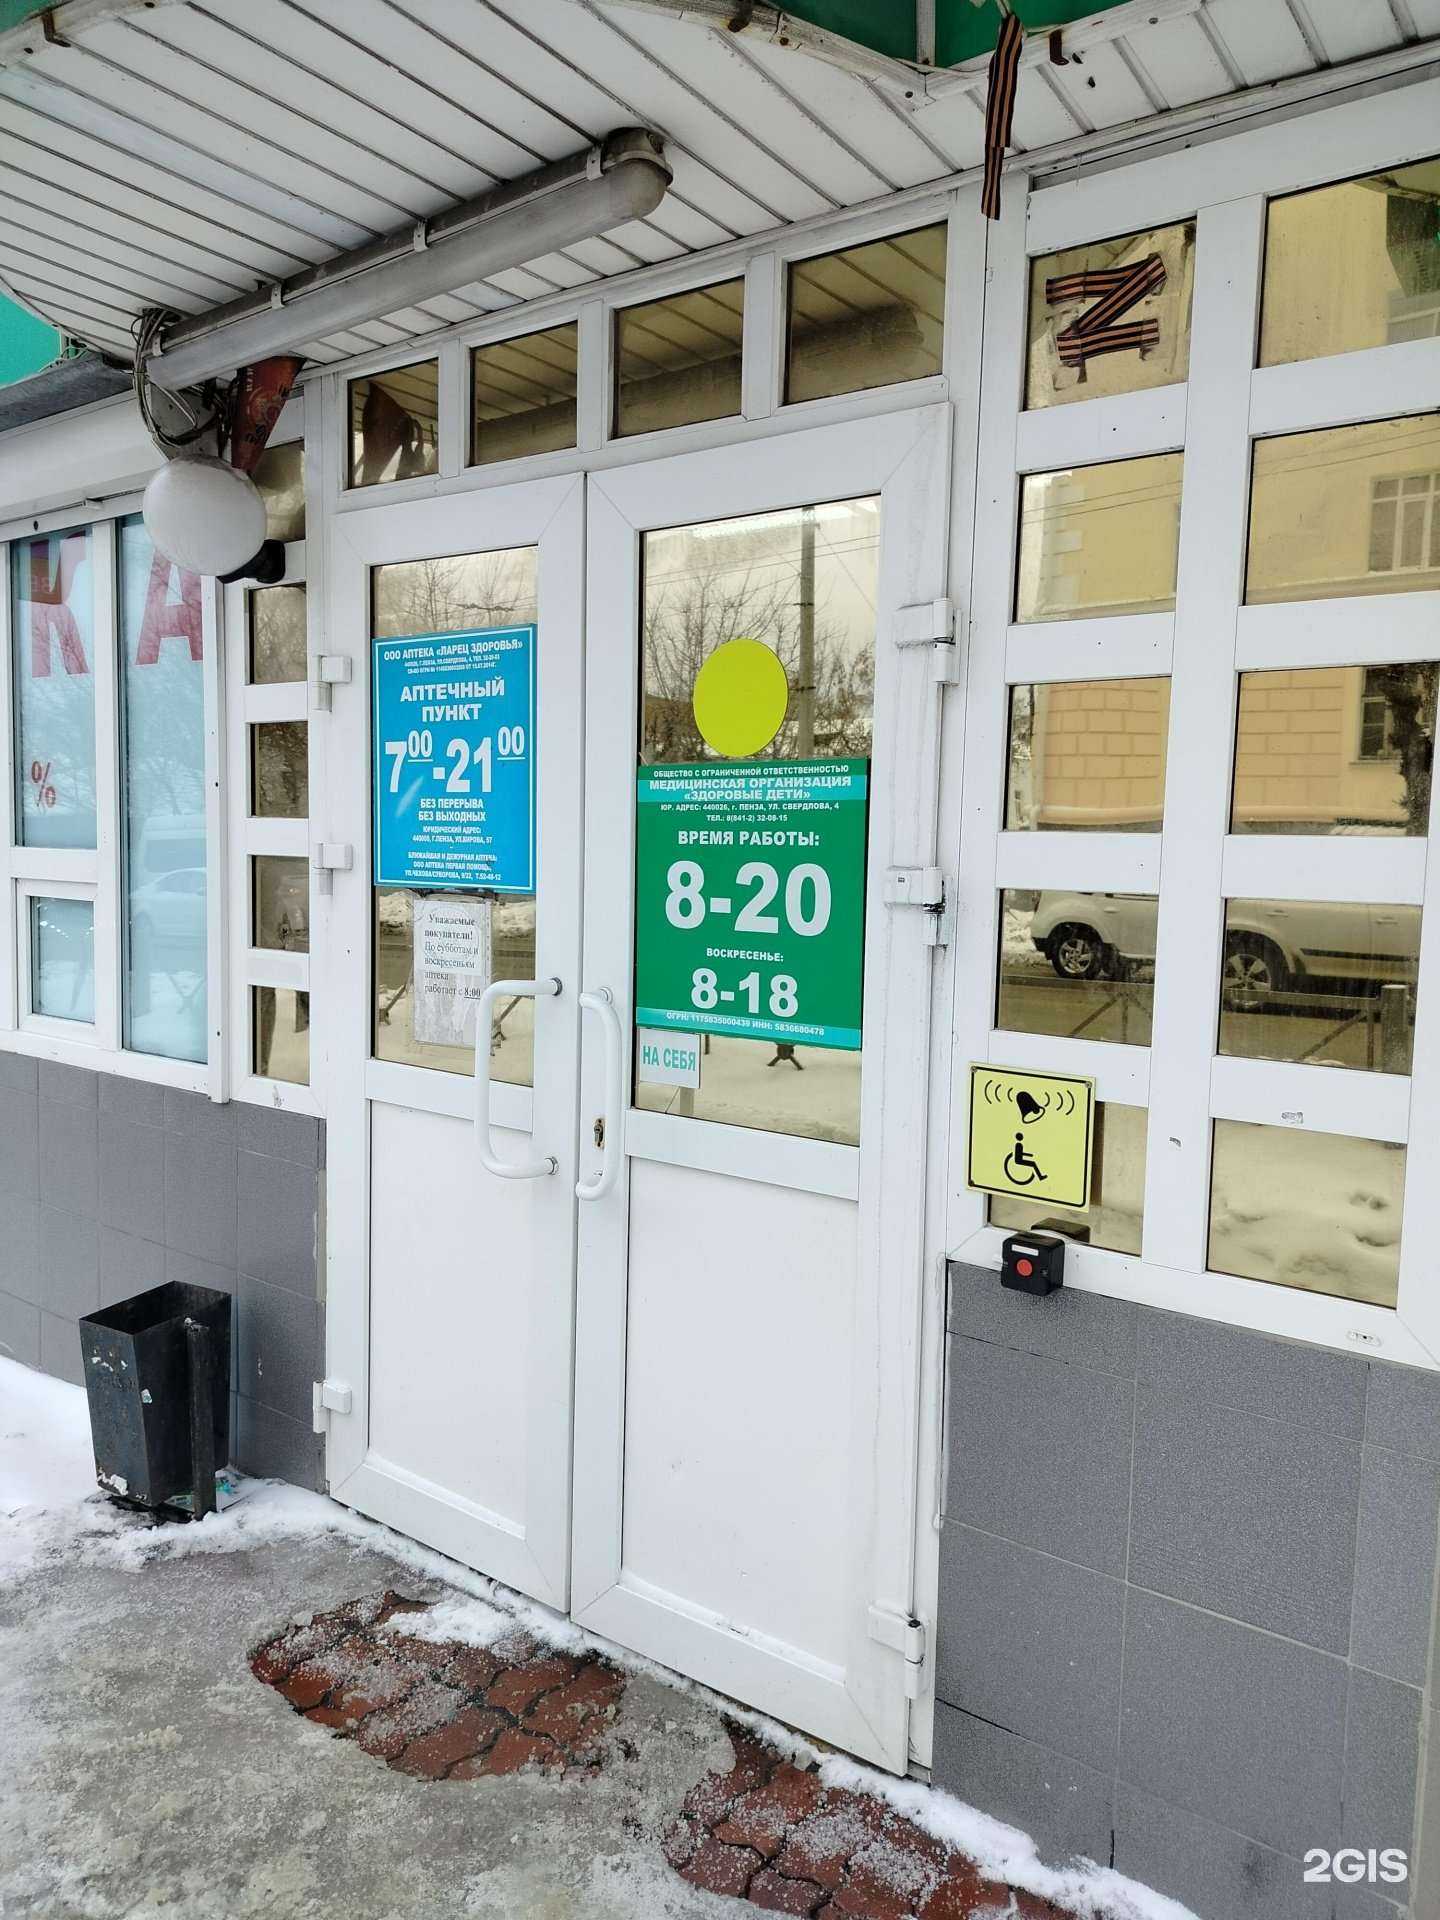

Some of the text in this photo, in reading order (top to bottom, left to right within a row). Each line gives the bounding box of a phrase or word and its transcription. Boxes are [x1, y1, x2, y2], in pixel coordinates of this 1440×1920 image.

[384, 639, 522, 661] ООО АПТЕКА «ЛАРЕЦ ЗДОРОВЬЯ»
[400, 676, 505, 702] АПТЕЧНЫЙ
[422, 704, 482, 722] ПУНКТ
[654, 770, 693, 778] ОБЩЕСТВО
[702, 767, 761, 777] ОГРАНИЧЕННОЙ
[763, 765, 849, 776] ОТВЕТСТВЕННОСТЬЮ
[650, 776, 852, 790] МЕДИЦИНСКАЯ ОРГАНИЗАЦИЯ
[684, 789, 811, 802] «ЗДОРОВЫЕ ДЕТИ»
[420, 798, 484, 809] БЕЗ ПЕРЕРЫВА
[676, 804, 701, 812] АДРЕС:
[739, 804, 767, 812] ПЕНЗА,
[782, 802, 832, 810] СВЕРДЛОВА,
[834, 802, 840, 810] 4
[418, 811, 486, 823] БЕЗ ВЫХОДНЫХ
[678, 831, 820, 846] ВРЕМЯ РАБОТЫ:
[665, 860, 832, 937] 8-20
[428, 914, 476, 926] Уважаемые
[424, 930, 473, 941] покупатели!
[424, 942, 436, 952] По
[436, 942, 473, 956] субботам
[706, 948, 784, 962] ВОСКРЕСЕНЬЕ:
[424, 957, 475, 969] воскресеньям
[424, 970, 449, 980] аптека
[691, 968, 799, 1018] 8-18
[666, 1012, 689, 1022] ОГРН:
[752, 1020, 773, 1031] ИНН:
[642, 1046, 696, 1072] НА СЕБЯ
